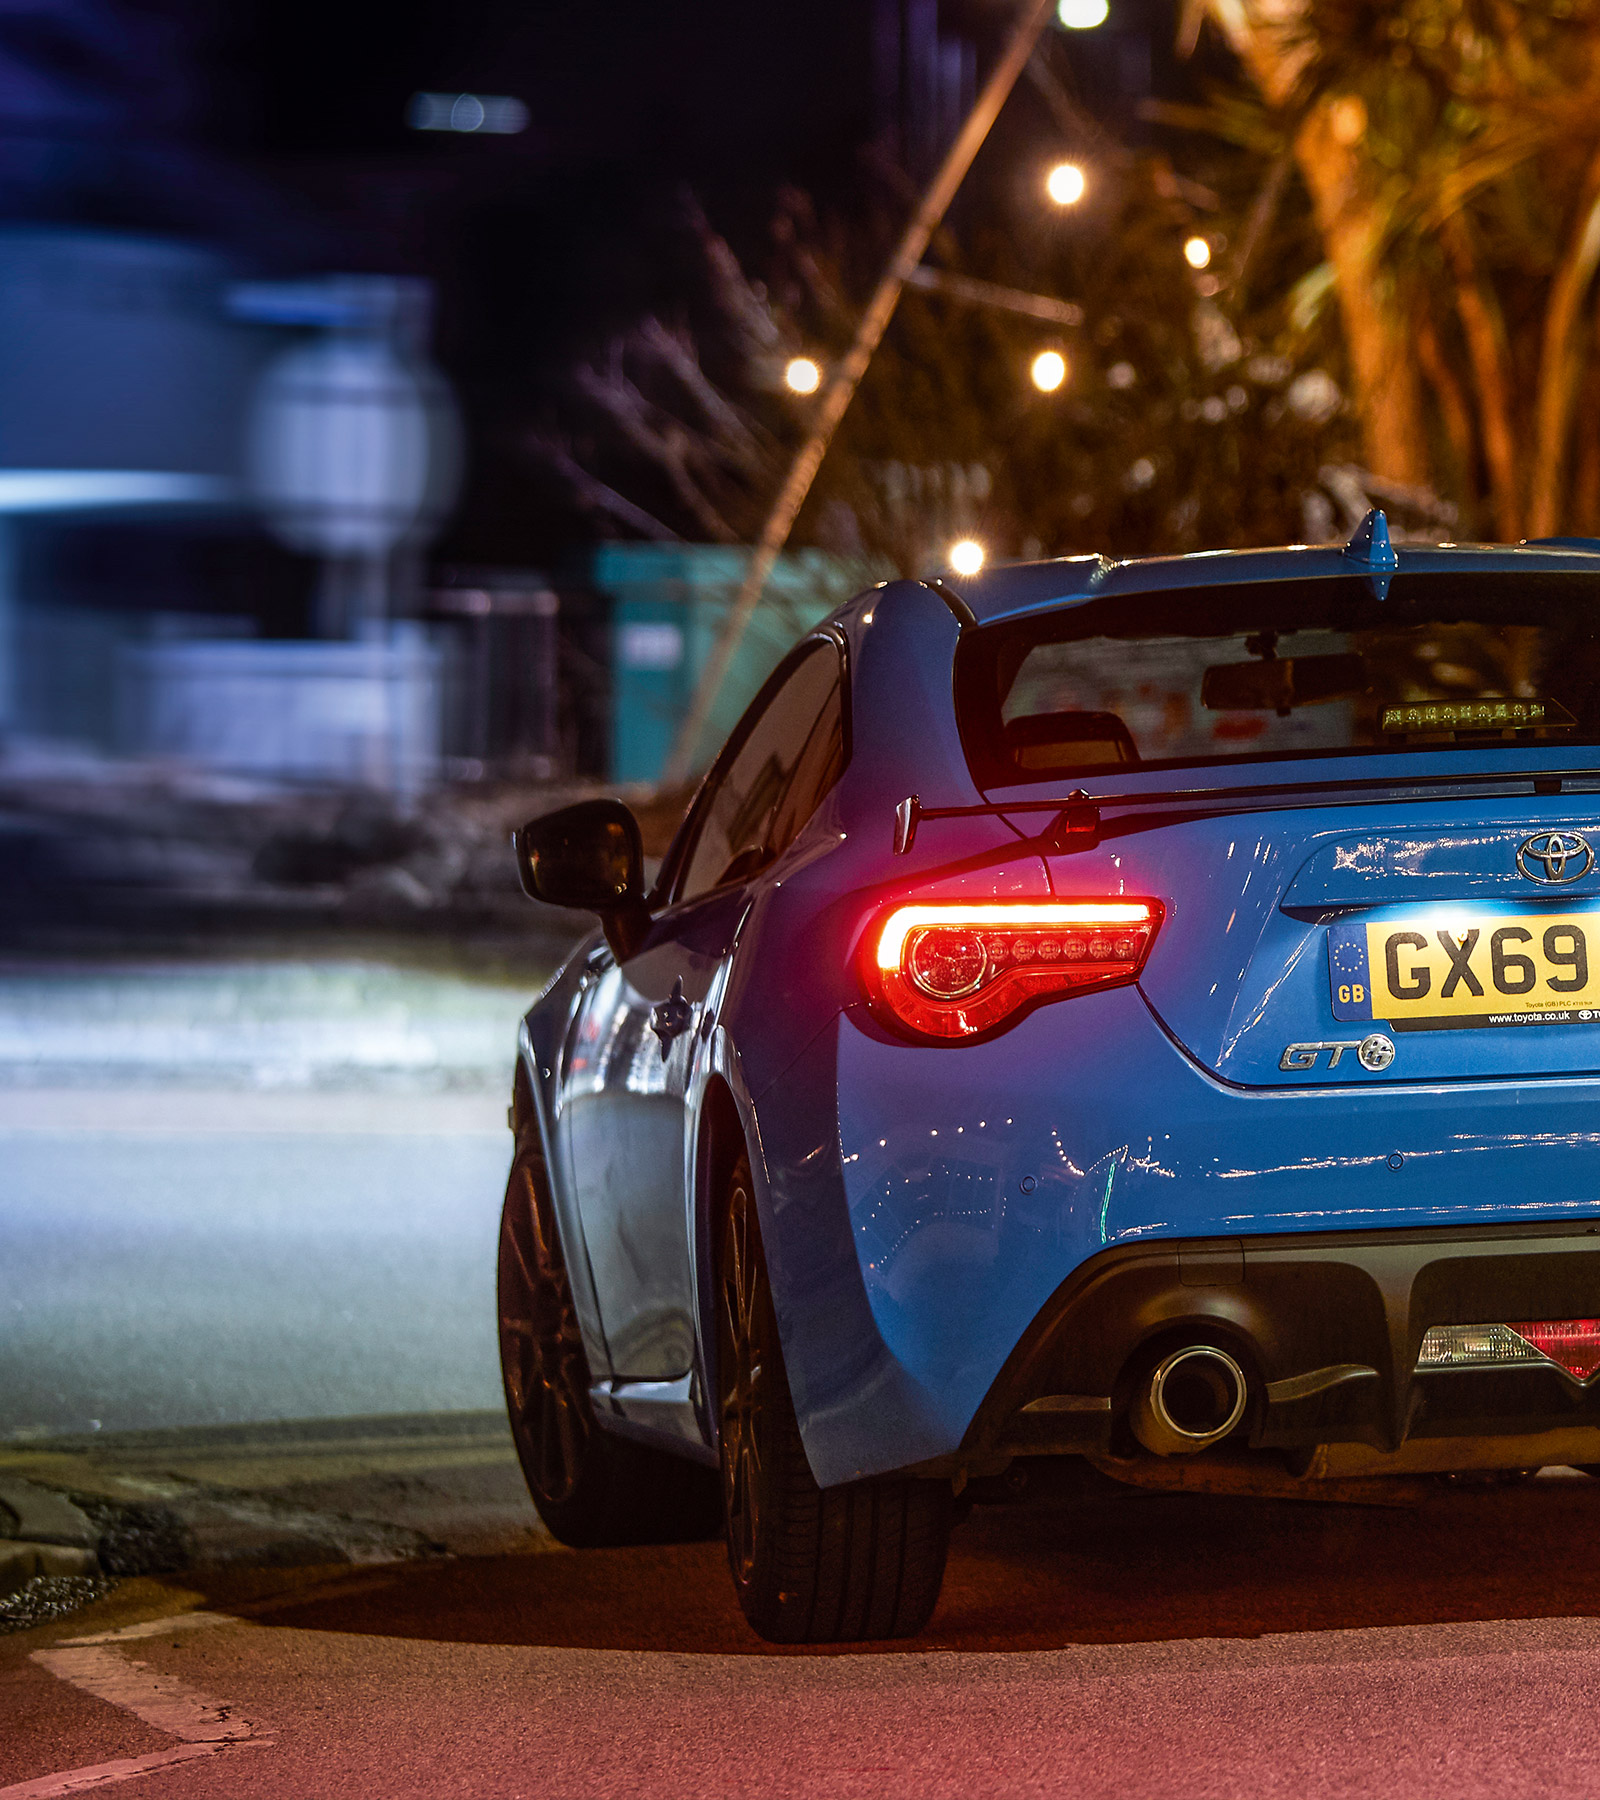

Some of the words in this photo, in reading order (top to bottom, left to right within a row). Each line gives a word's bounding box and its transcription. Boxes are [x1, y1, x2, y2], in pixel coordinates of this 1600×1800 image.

[1385, 925, 1589, 1000] GX69
[1338, 984, 1365, 1003] GB
[1488, 1011, 1570, 1024] www.toyota.co.uk
